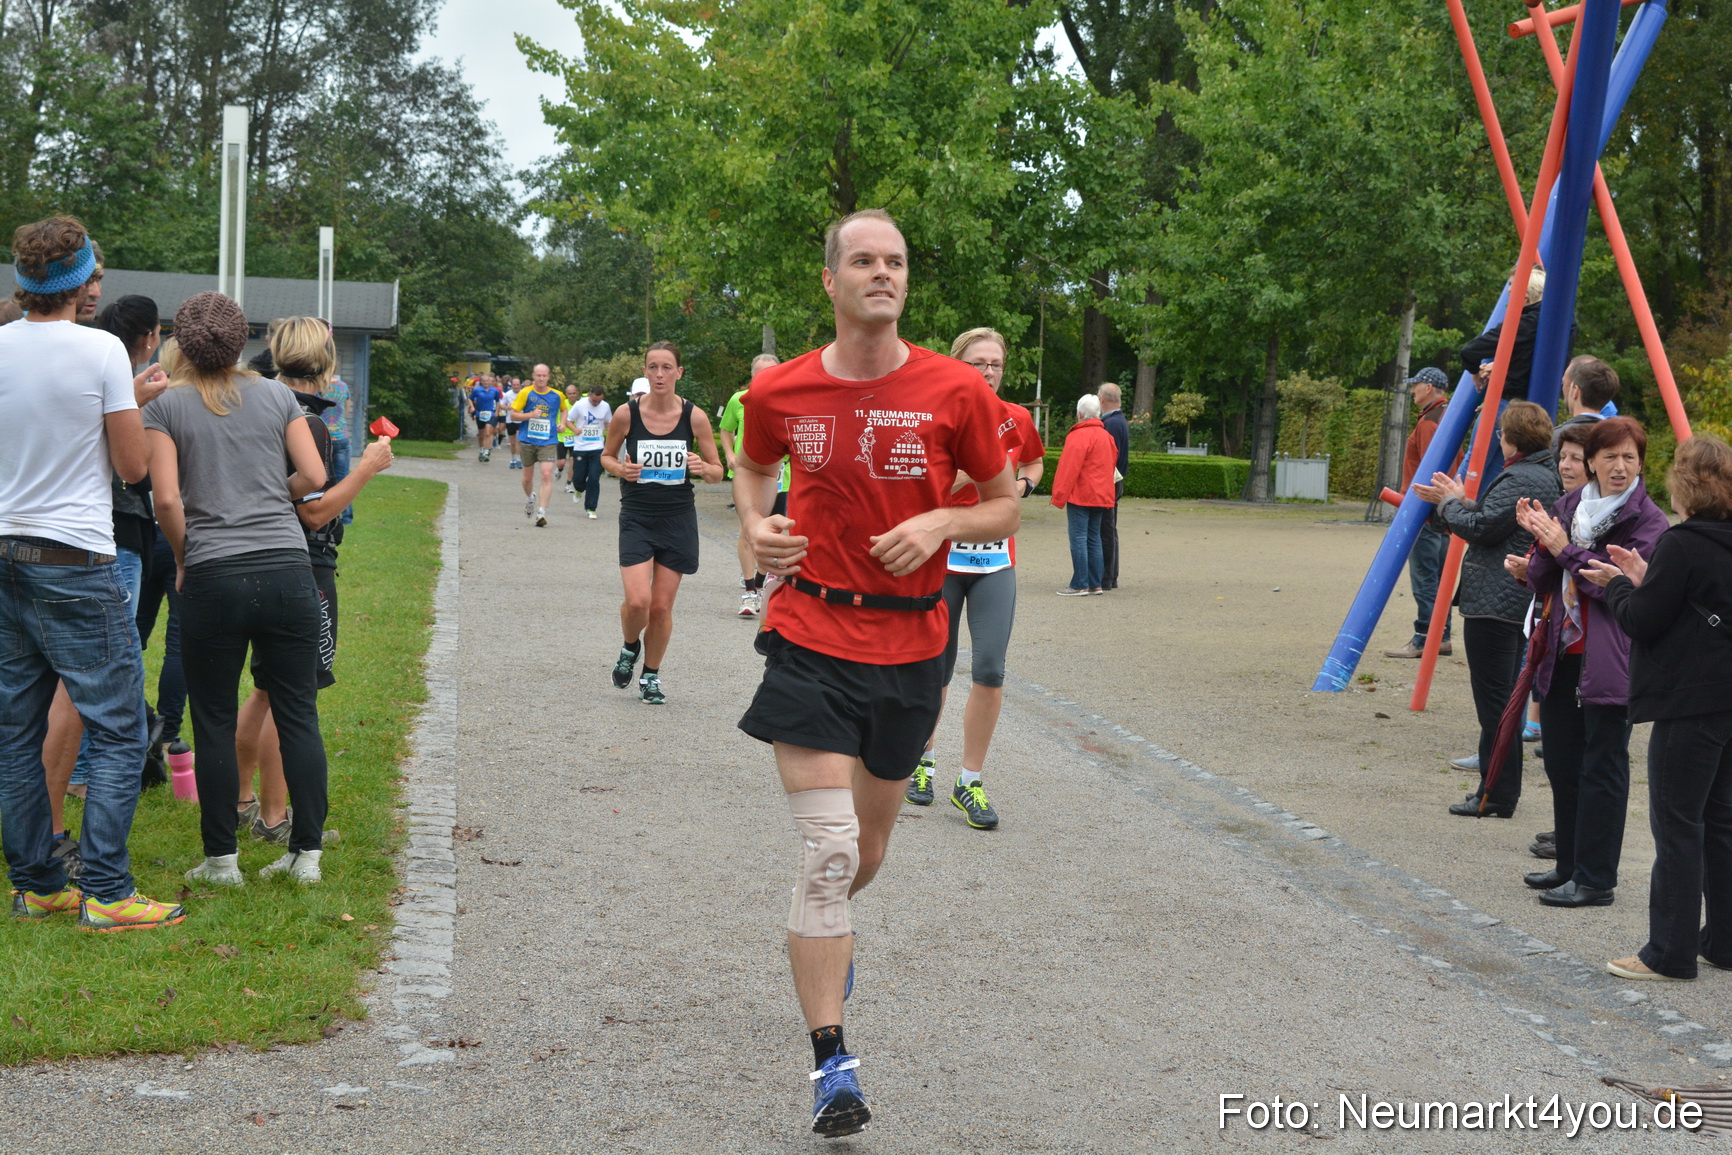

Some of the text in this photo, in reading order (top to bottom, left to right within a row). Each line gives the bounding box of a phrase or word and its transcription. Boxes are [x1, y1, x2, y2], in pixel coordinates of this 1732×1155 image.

[870, 410, 933, 421] NEUMARKTER
[867, 417, 920, 427] STADTLAUF
[530, 422, 548, 432] 2081
[793, 424, 825, 432] IMMER
[583, 429, 599, 437] 2831
[793, 433, 827, 441] WIEDER
[796, 442, 824, 454] NEU
[643, 451, 684, 468] 2019
[653, 471, 672, 479] Petra
[970, 556, 990, 565] Petra
